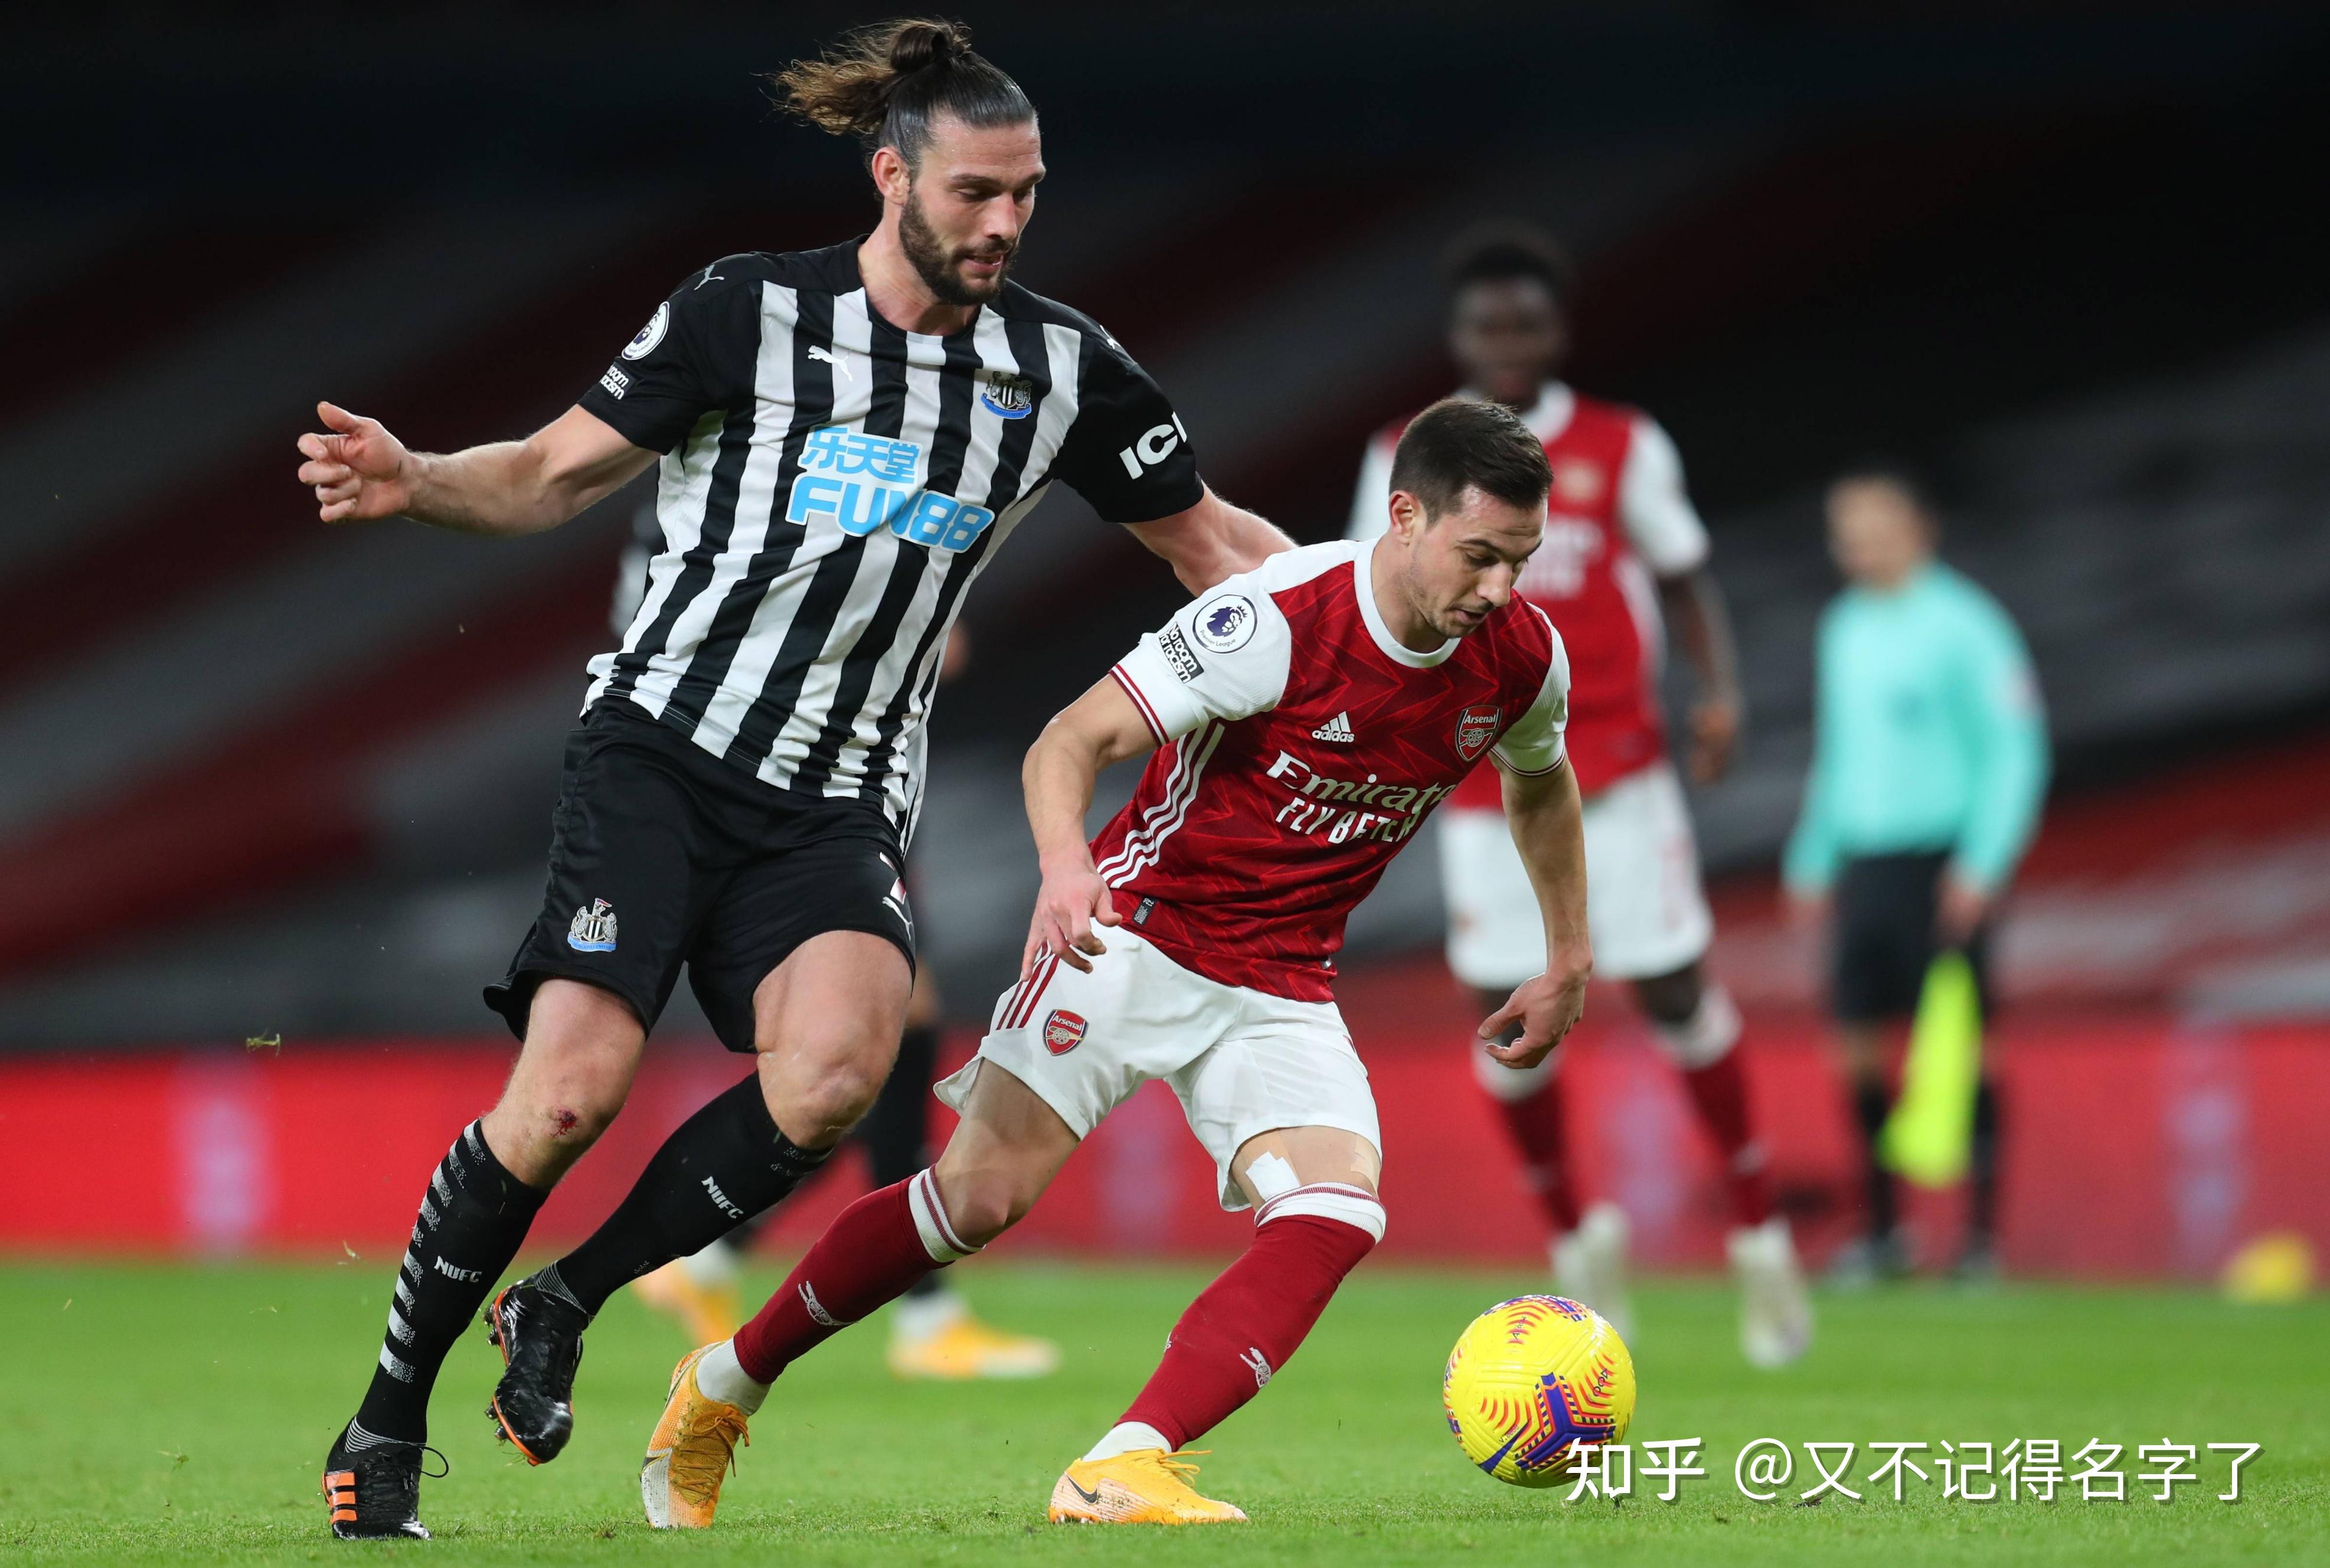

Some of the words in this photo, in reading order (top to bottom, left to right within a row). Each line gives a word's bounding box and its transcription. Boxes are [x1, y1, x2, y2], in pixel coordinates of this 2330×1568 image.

[800, 426, 920, 484] 乐天堂
[789, 475, 993, 551] FUN88
[1172, 638, 1198, 672] room
[1215, 639, 1236, 647] League
[1163, 643, 1191, 684] racism
[1312, 729, 1355, 743] adidas
[1463, 714, 1496, 724] Arsenal
[1275, 797, 1336, 835] FLY
[1052, 1015, 1082, 1031] Arsenal
[701, 1176, 744, 1219] NUFC
[434, 1255, 482, 1283] NUFC
